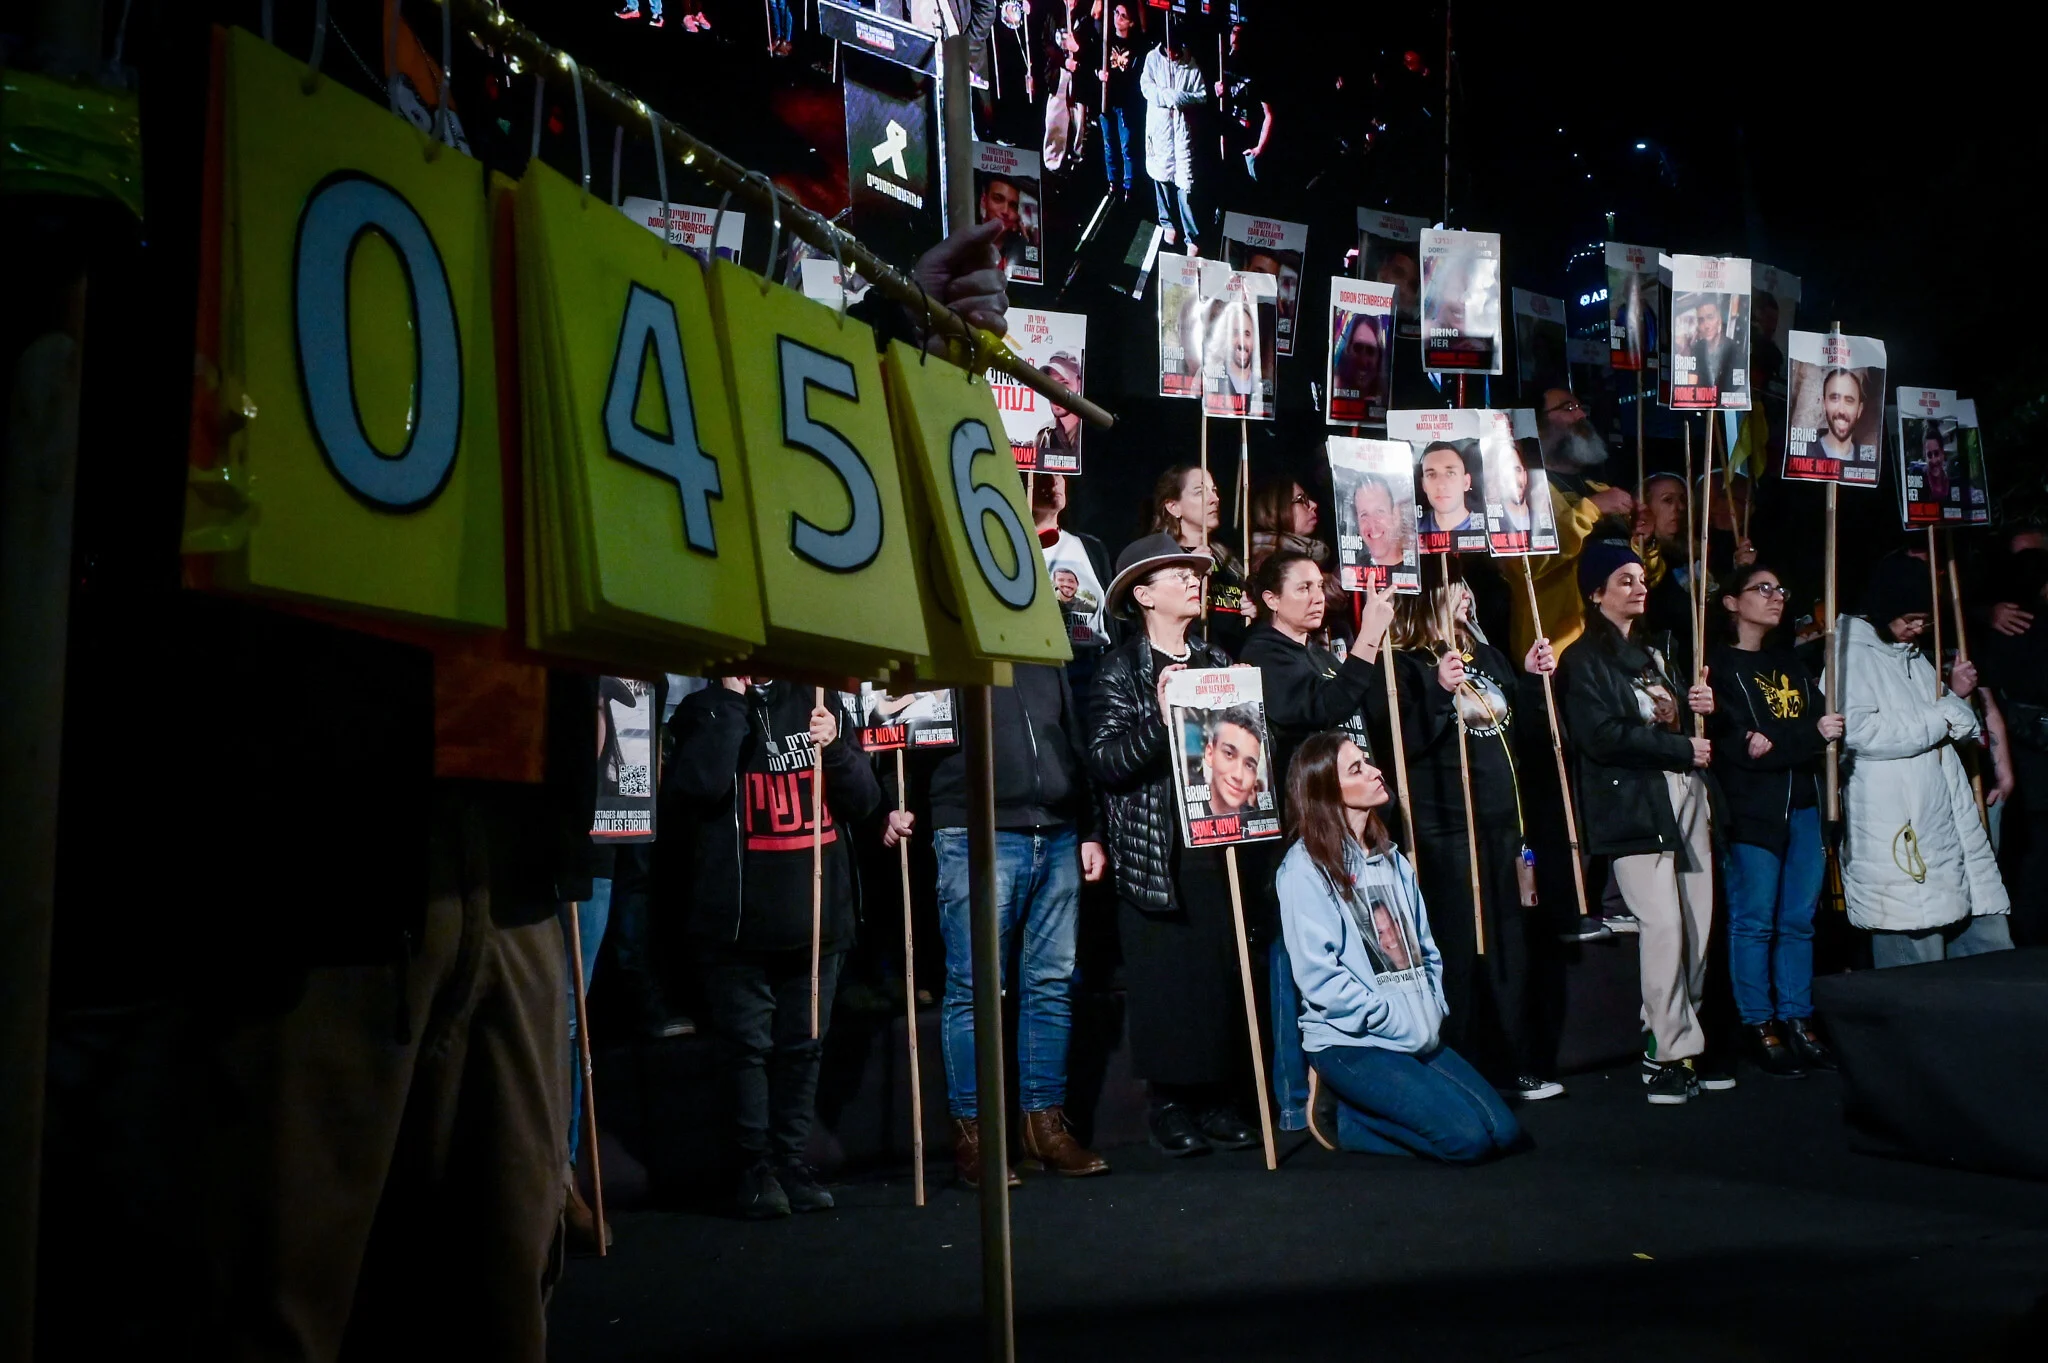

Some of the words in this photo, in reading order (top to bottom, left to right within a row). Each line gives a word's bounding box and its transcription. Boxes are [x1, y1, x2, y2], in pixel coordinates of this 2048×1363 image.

[647, 216, 666, 229] DORO
[1339, 290, 1357, 302] DORON
[1357, 293, 1393, 308] STEINBRECHER
[1024, 323, 1035, 333] ITAY
[1036, 325, 1049, 335] CHEN
[1430, 327, 1459, 337] BRING
[1430, 338, 1449, 348] HER
[1163, 346, 1185, 360] BRING
[1163, 360, 1177, 373] HIM
[1674, 354, 1697, 370] BRING
[1674, 370, 1689, 385] HIM
[1416, 422, 1433, 431] MATAN
[1433, 422, 1454, 431] ANGREST
[1790, 427, 1817, 443] BRING
[1789, 441, 1808, 456] HIM
[1788, 457, 1814, 472] HOME
[1815, 458, 1840, 473] NOW!
[1340, 534, 1363, 550] BRING
[1342, 549, 1356, 565] HIM
[1195, 685, 1209, 695] EDAN
[1208, 683, 1236, 694] ALEXANDER
[875, 724, 905, 744] NOW!
[1469, 727, 1484, 738] TAL
[1184, 784, 1211, 802] BRING
[594, 810, 616, 819] STAGES
[616, 810, 628, 819] AND
[627, 810, 651, 819] MISSING
[1187, 801, 1206, 820] HIM
[593, 819, 623, 832] AMILIES
[624, 819, 651, 832] FORUM
[1190, 820, 1215, 838] HOME
[1215, 815, 1241, 835] NOW!
